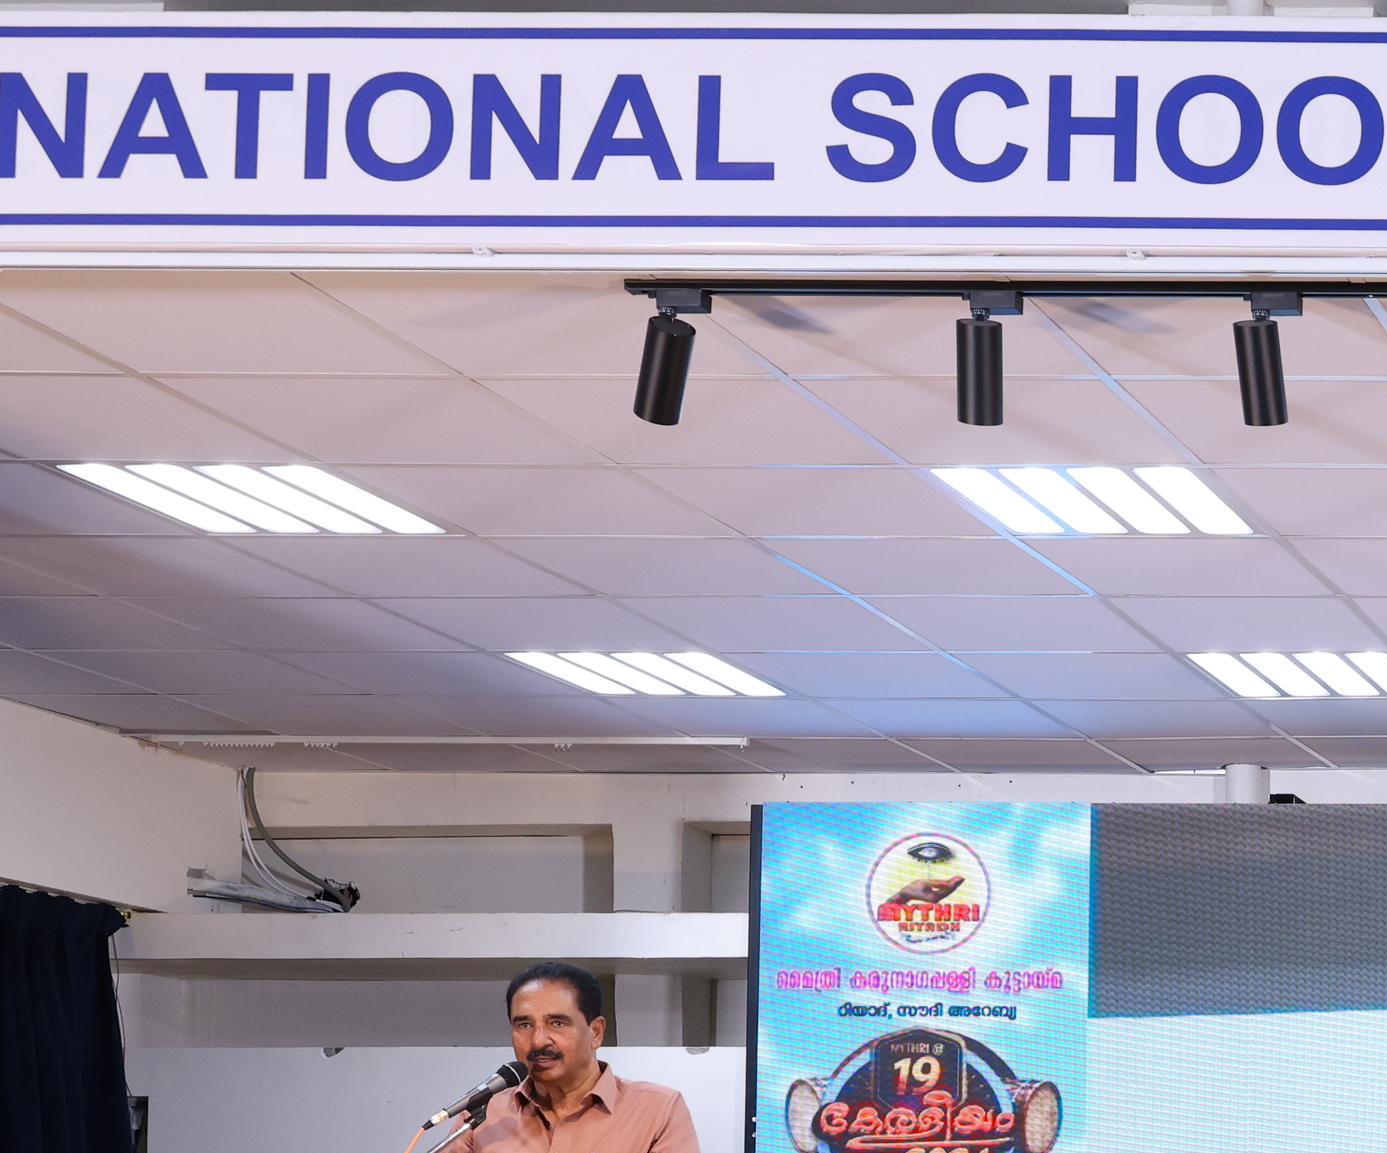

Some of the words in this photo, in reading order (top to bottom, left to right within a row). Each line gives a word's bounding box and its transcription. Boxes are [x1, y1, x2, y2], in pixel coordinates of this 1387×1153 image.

[0, 73, 777, 182] NATIONAL
[877, 903, 980, 921] MYTHRI
[894, 1055, 941, 1096] 19
